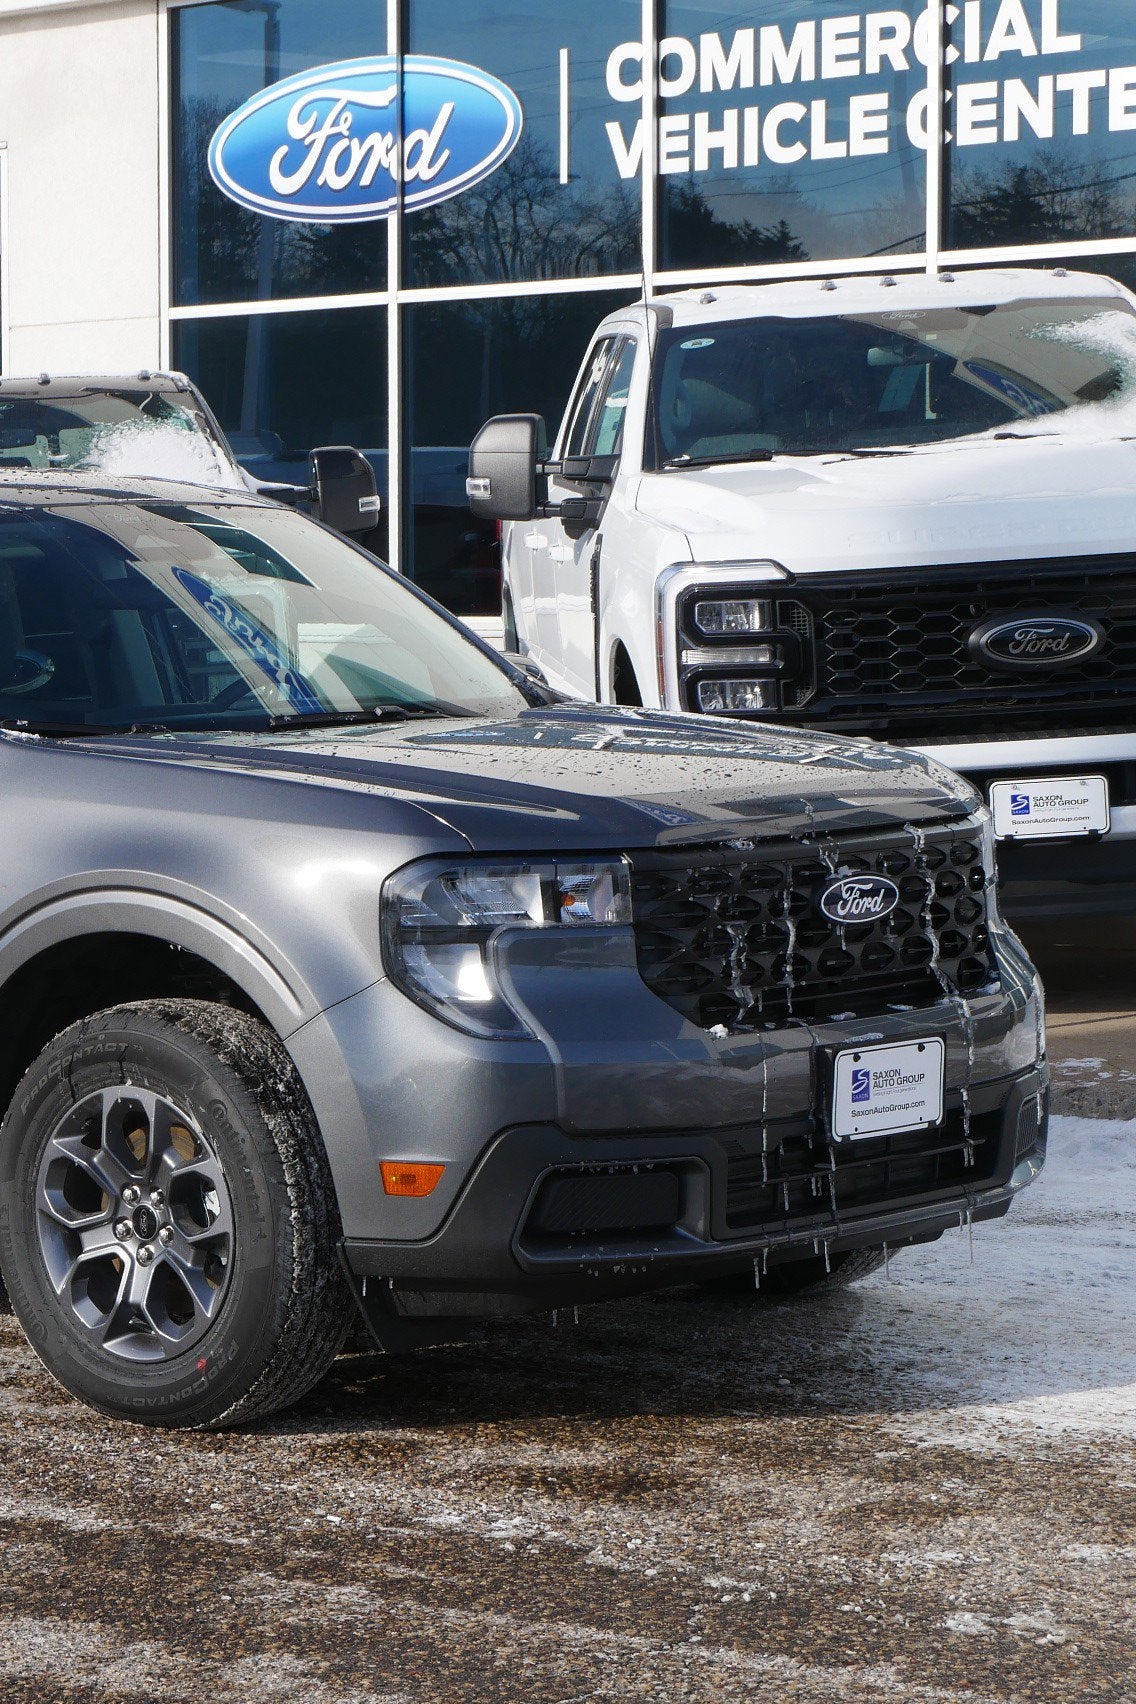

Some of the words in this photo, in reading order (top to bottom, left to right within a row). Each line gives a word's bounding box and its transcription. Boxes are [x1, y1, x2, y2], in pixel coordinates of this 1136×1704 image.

[605, 0, 1083, 102] COMMERCIAL
[269, 83, 455, 195] Ford
[605, 93, 889, 179] VEHICLE
[1009, 627, 1070, 654] Ford
[1033, 800, 1056, 808] AUTO
[1058, 798, 1089, 806] GROUP
[1011, 816, 1090, 826] SaxonAutoGroup.com
[837, 882, 885, 916] Ford
[872, 1068, 901, 1081] SAXON
[873, 1078, 895, 1089] AUTO
[896, 1073, 925, 1086] GROUP
[851, 1100, 926, 1118] SaxonAutoGroup.com
